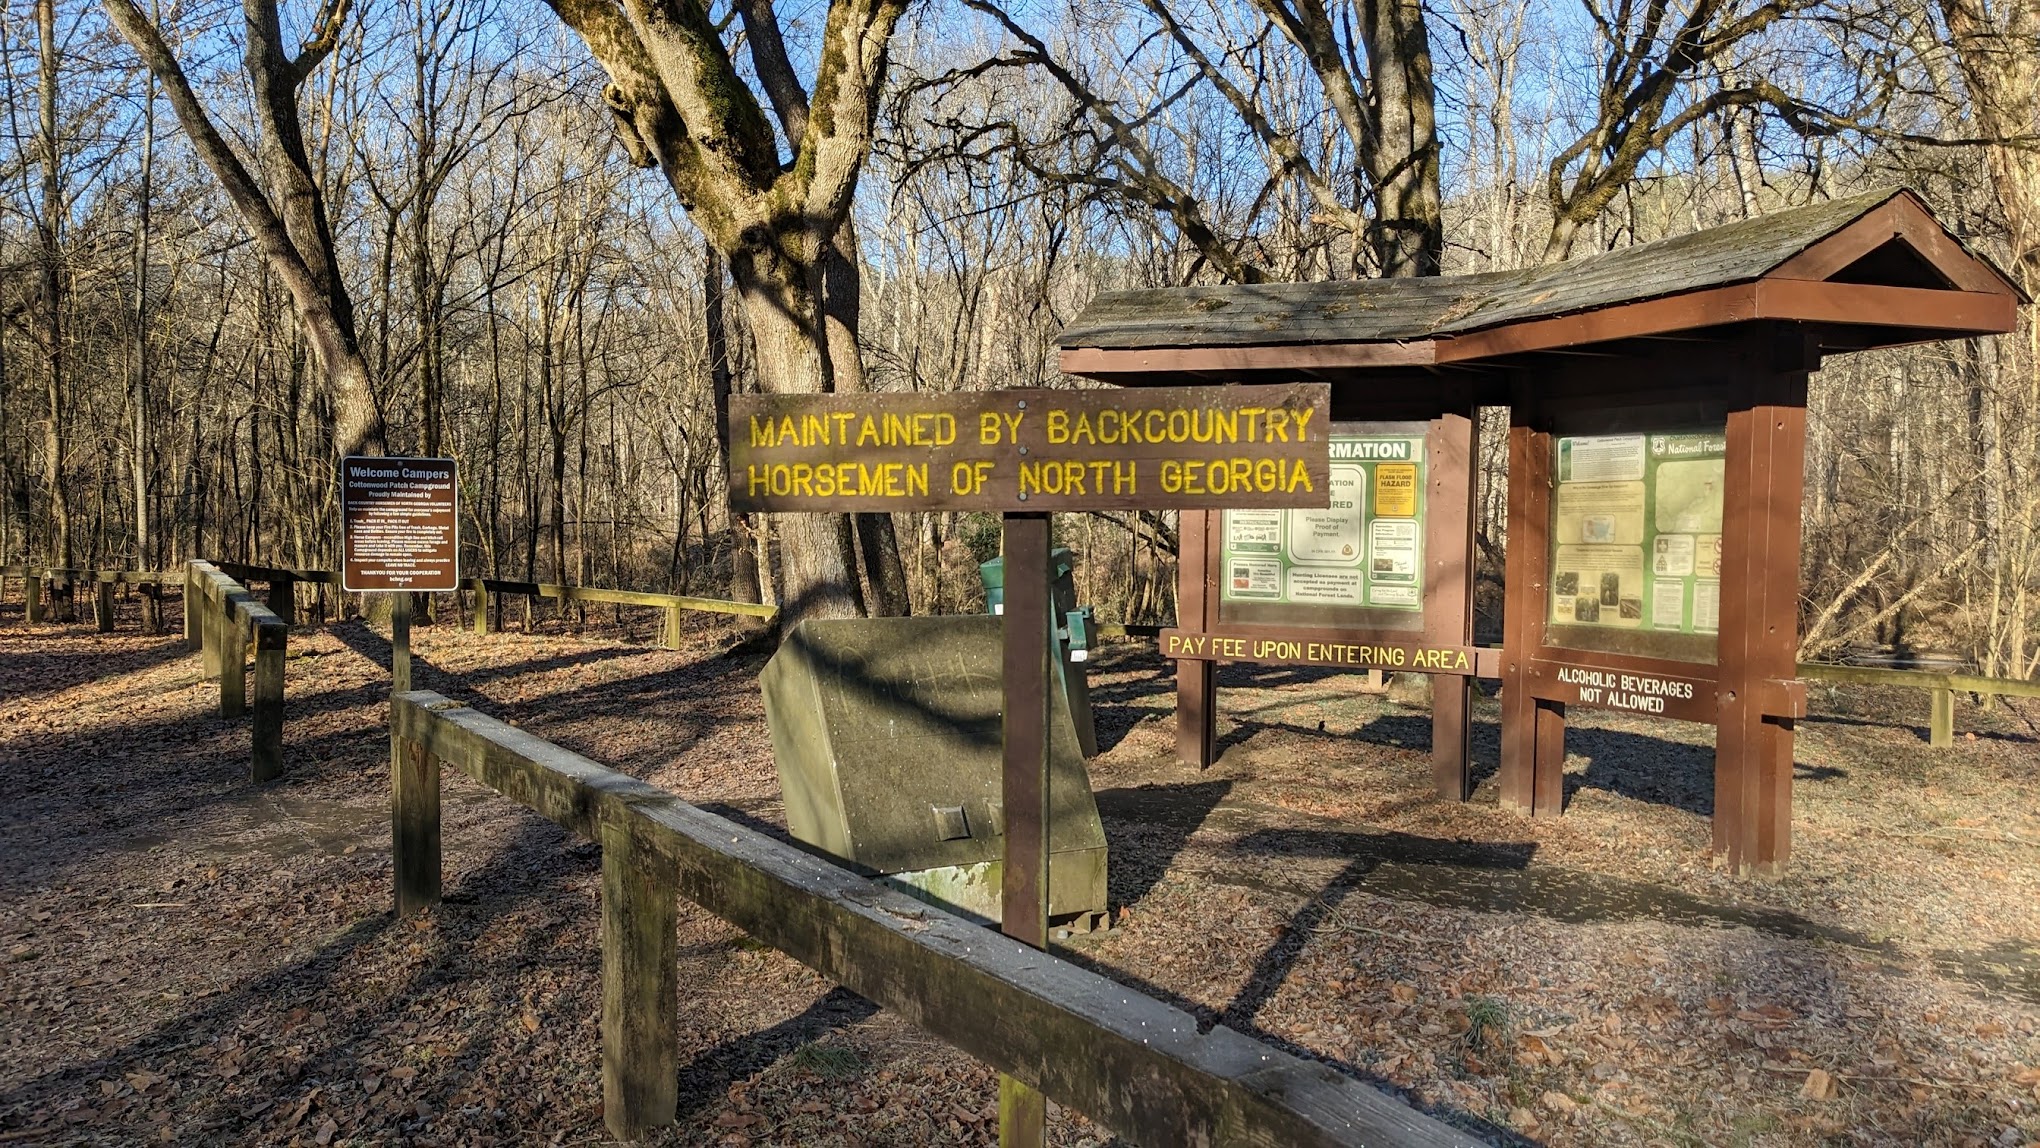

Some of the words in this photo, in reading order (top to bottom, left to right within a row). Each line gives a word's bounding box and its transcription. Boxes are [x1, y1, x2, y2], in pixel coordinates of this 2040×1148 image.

[750, 412, 957, 447] MAINTAINED
[979, 411, 1024, 445] BY
[1046, 407, 1314, 445] BACKCOUNTRY
[1329, 442, 1406, 458] RMATION
[1668, 441, 1702, 454] National
[350, 467, 399, 478] Welcome
[402, 468, 449, 480] Campers
[748, 462, 929, 496] HORSEMEN
[951, 461, 995, 496] OF
[1019, 460, 1136, 496] NORTH
[1160, 458, 1313, 495] GEORGIA
[1169, 636, 1206, 655] PAY
[1211, 638, 1246, 658] FEE
[1253, 640, 1301, 660] UPON
[1308, 643, 1405, 666] ENTERING
[1412, 649, 1468, 670] AREA
[1558, 667, 1616, 688] ALCOHOLIC
[1621, 675, 1693, 699] BEVERAGES
[1579, 687, 1602, 704] NOT
[1607, 691, 1664, 713] ALLOWED
